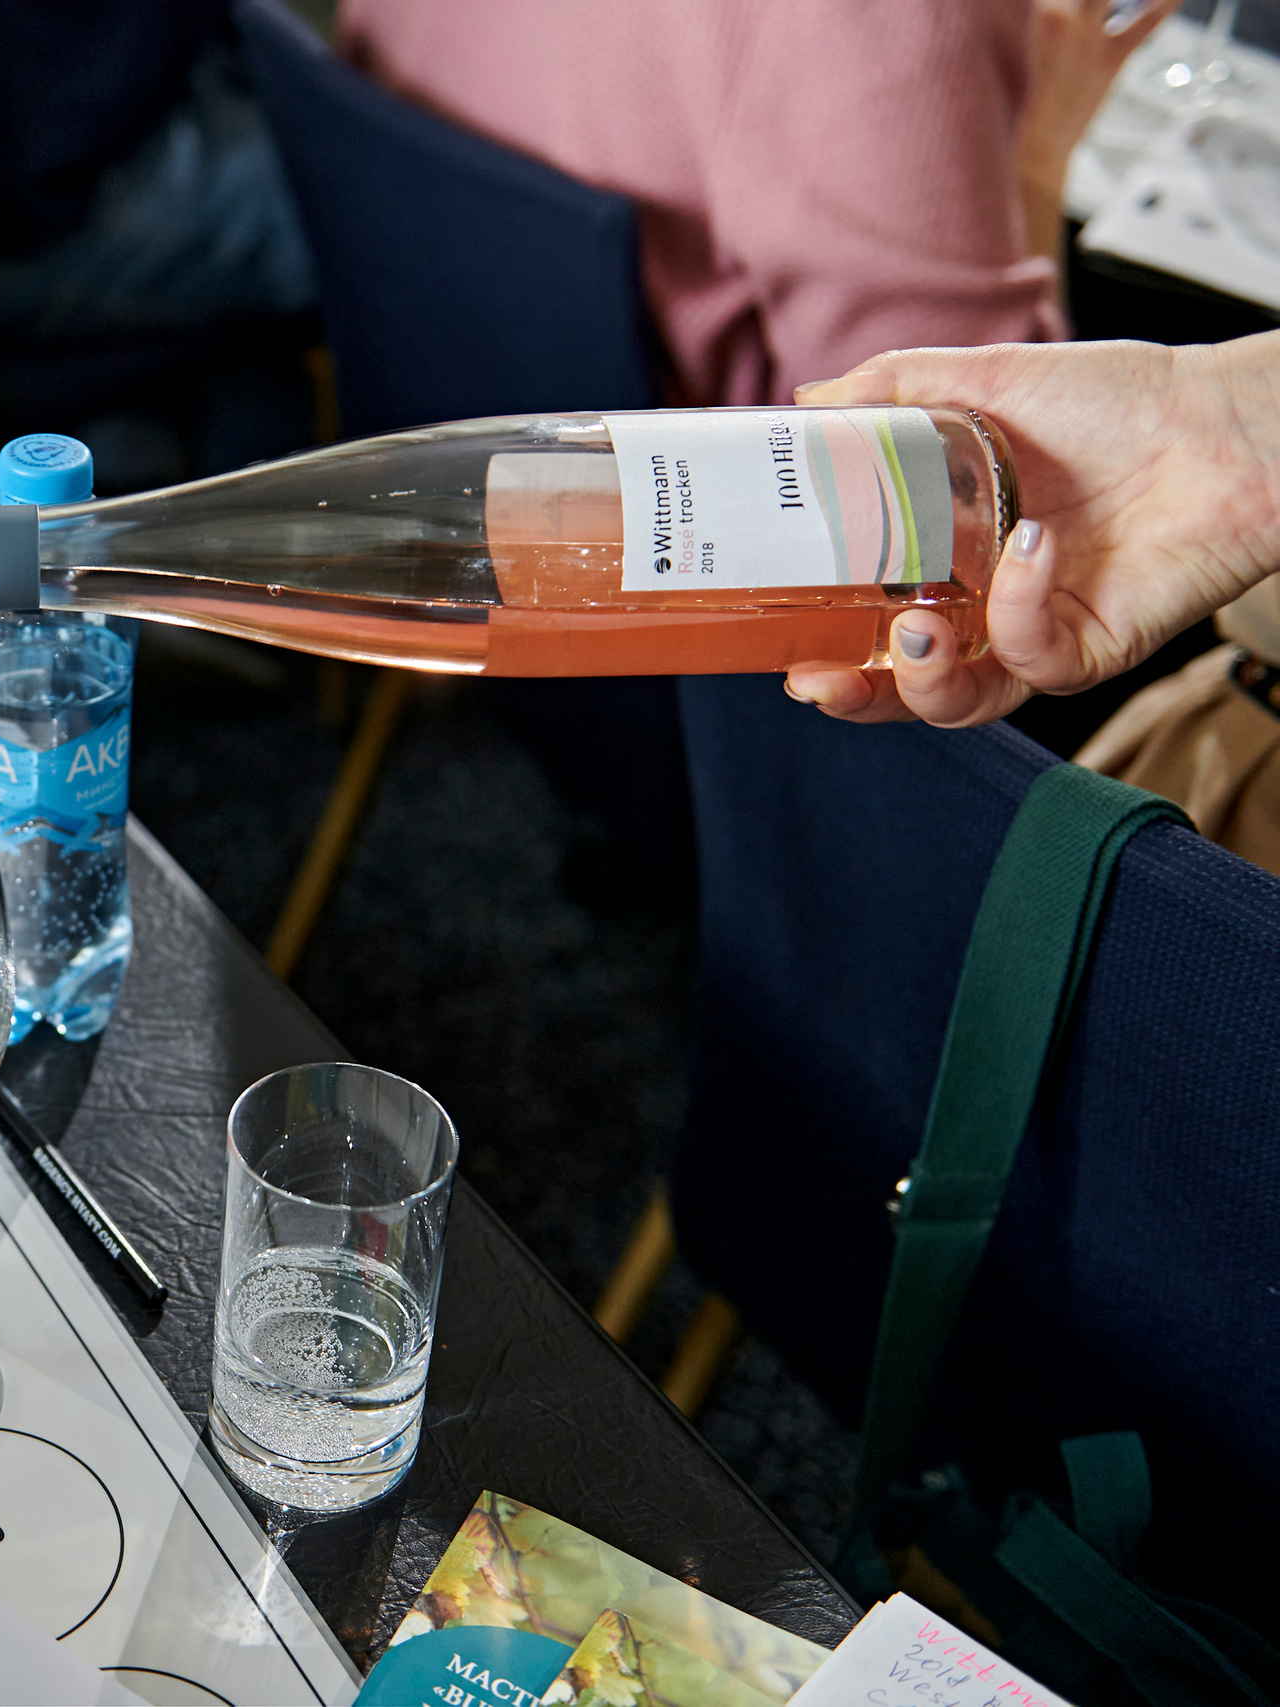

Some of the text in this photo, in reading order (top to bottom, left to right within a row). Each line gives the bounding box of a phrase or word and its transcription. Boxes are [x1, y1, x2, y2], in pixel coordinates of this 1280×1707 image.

[651, 454, 672, 554] Wittmann
[675, 459, 694, 574] Rosé trocken
[776, 468, 805, 511] 100
[701, 542, 715, 574] 2018
